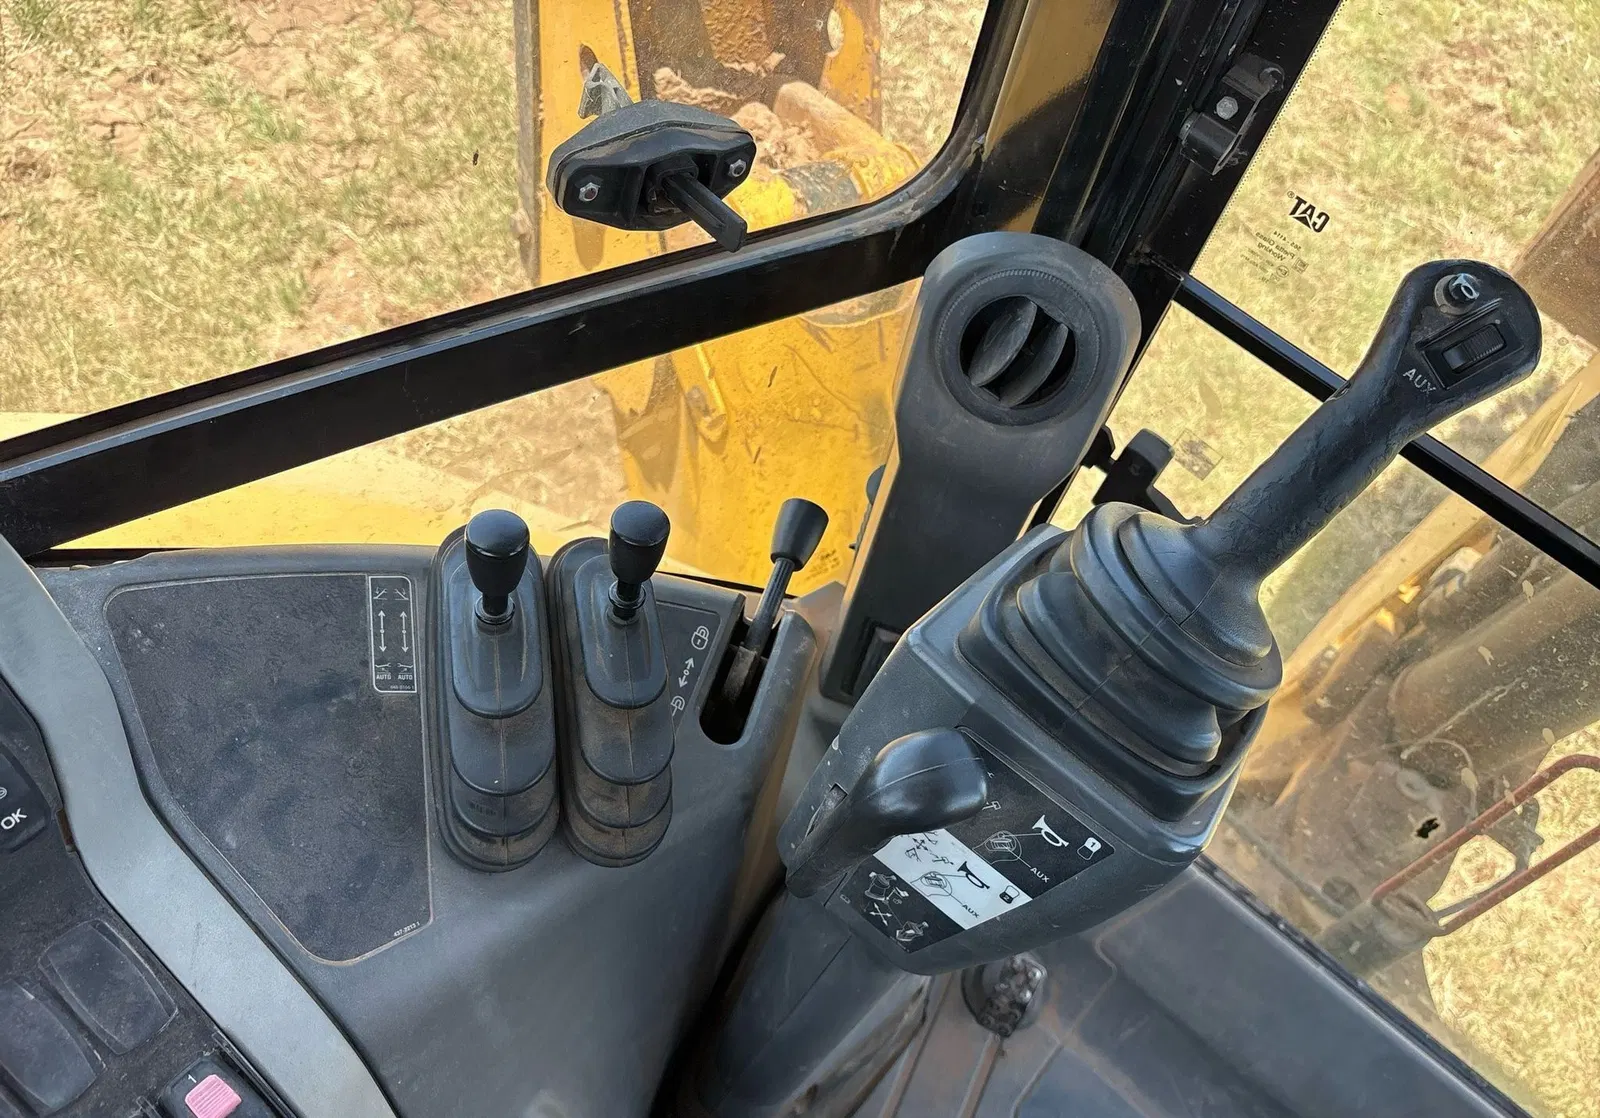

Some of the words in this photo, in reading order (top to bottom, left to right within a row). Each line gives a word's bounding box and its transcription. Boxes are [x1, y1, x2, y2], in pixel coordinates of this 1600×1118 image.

[1402, 368, 1437, 397] AUX
[1, 807, 27, 829] OK
[1030, 866, 1050, 883] AUX
[962, 904, 980, 919] AUX
[187, 1074, 197, 1084] 1
